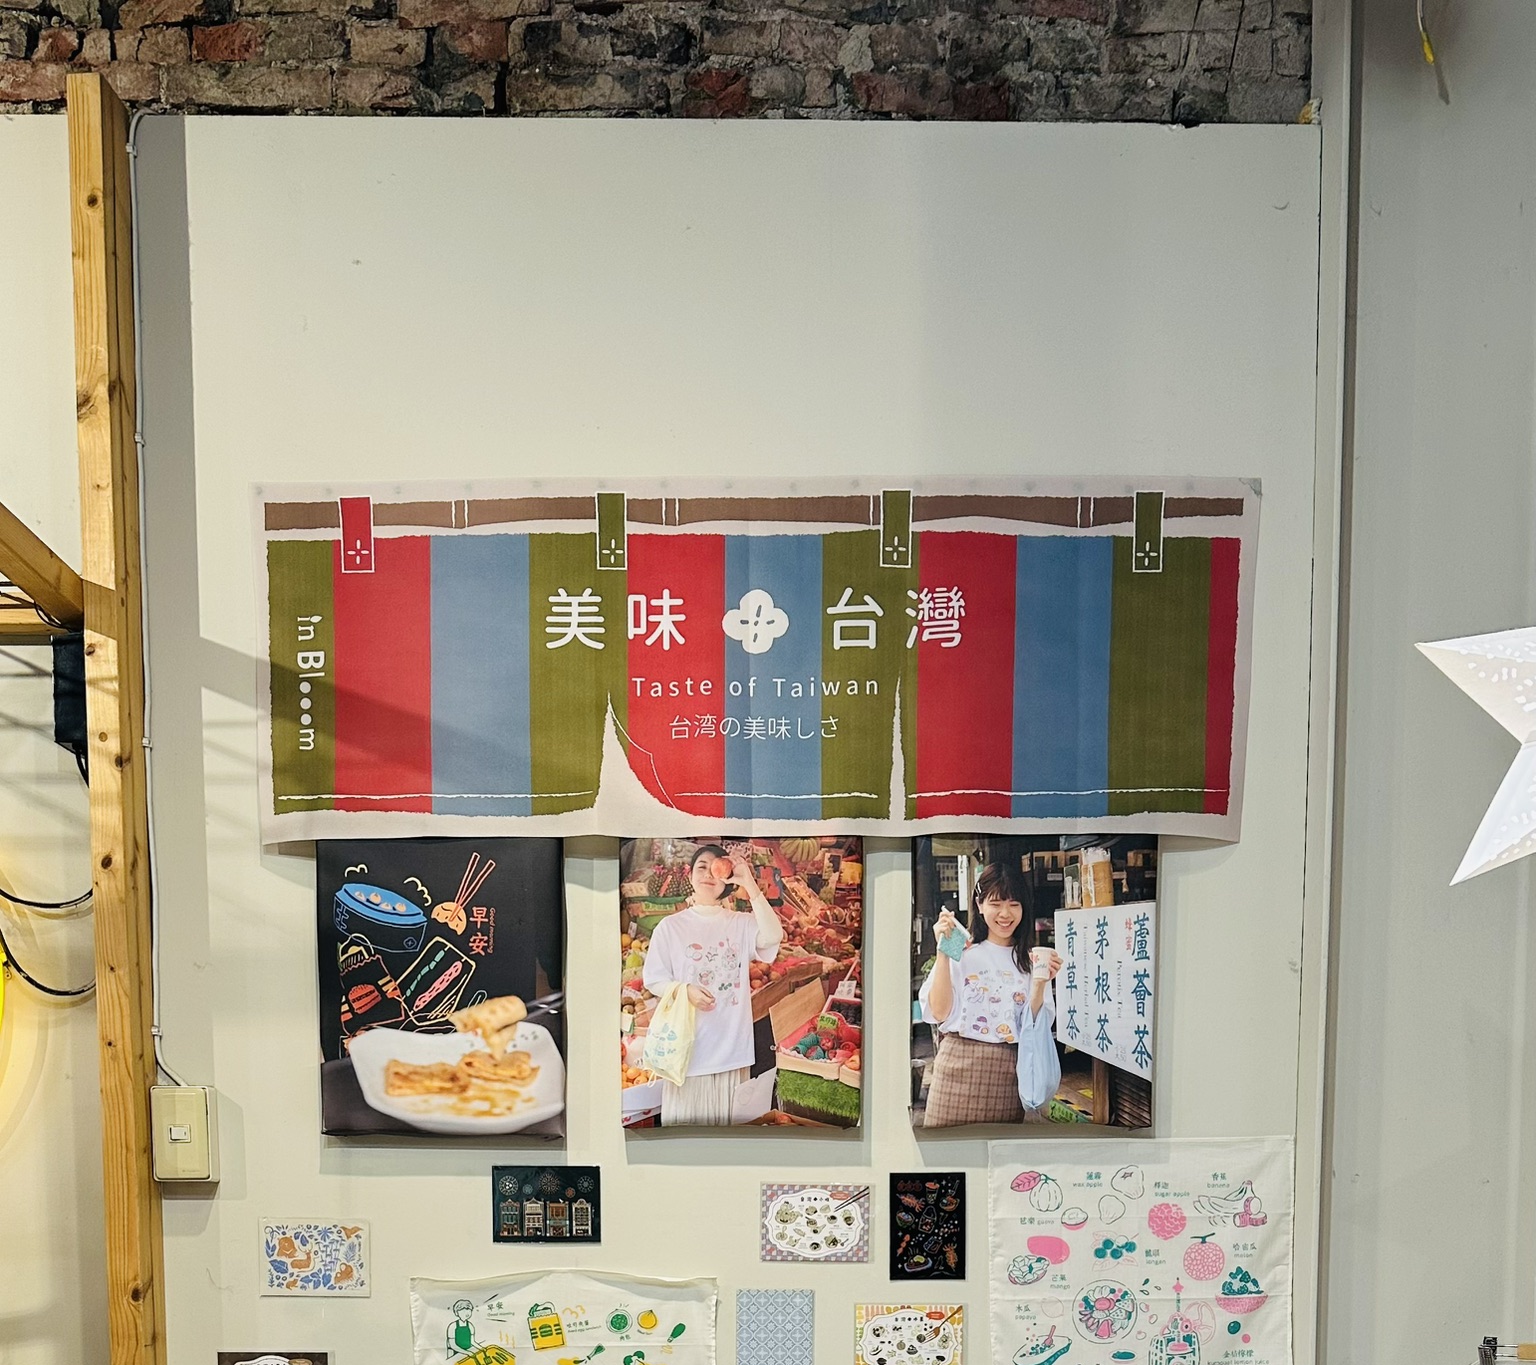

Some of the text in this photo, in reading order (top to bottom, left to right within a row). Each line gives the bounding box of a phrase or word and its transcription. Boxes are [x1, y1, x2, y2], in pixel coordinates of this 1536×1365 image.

[296, 614, 323, 641] in
[544, 586, 966, 651] 美味 台灣
[631, 676, 879, 697] Taste of Taiwan
[668, 713, 839, 741] 台湾の美味しさ
[469, 906, 488, 956] 早安
[1065, 918, 1080, 1041] 青草茶
[1094, 915, 1113, 1053] 茅根茶
[1131, 912, 1153, 1069] 蘆薈茶
